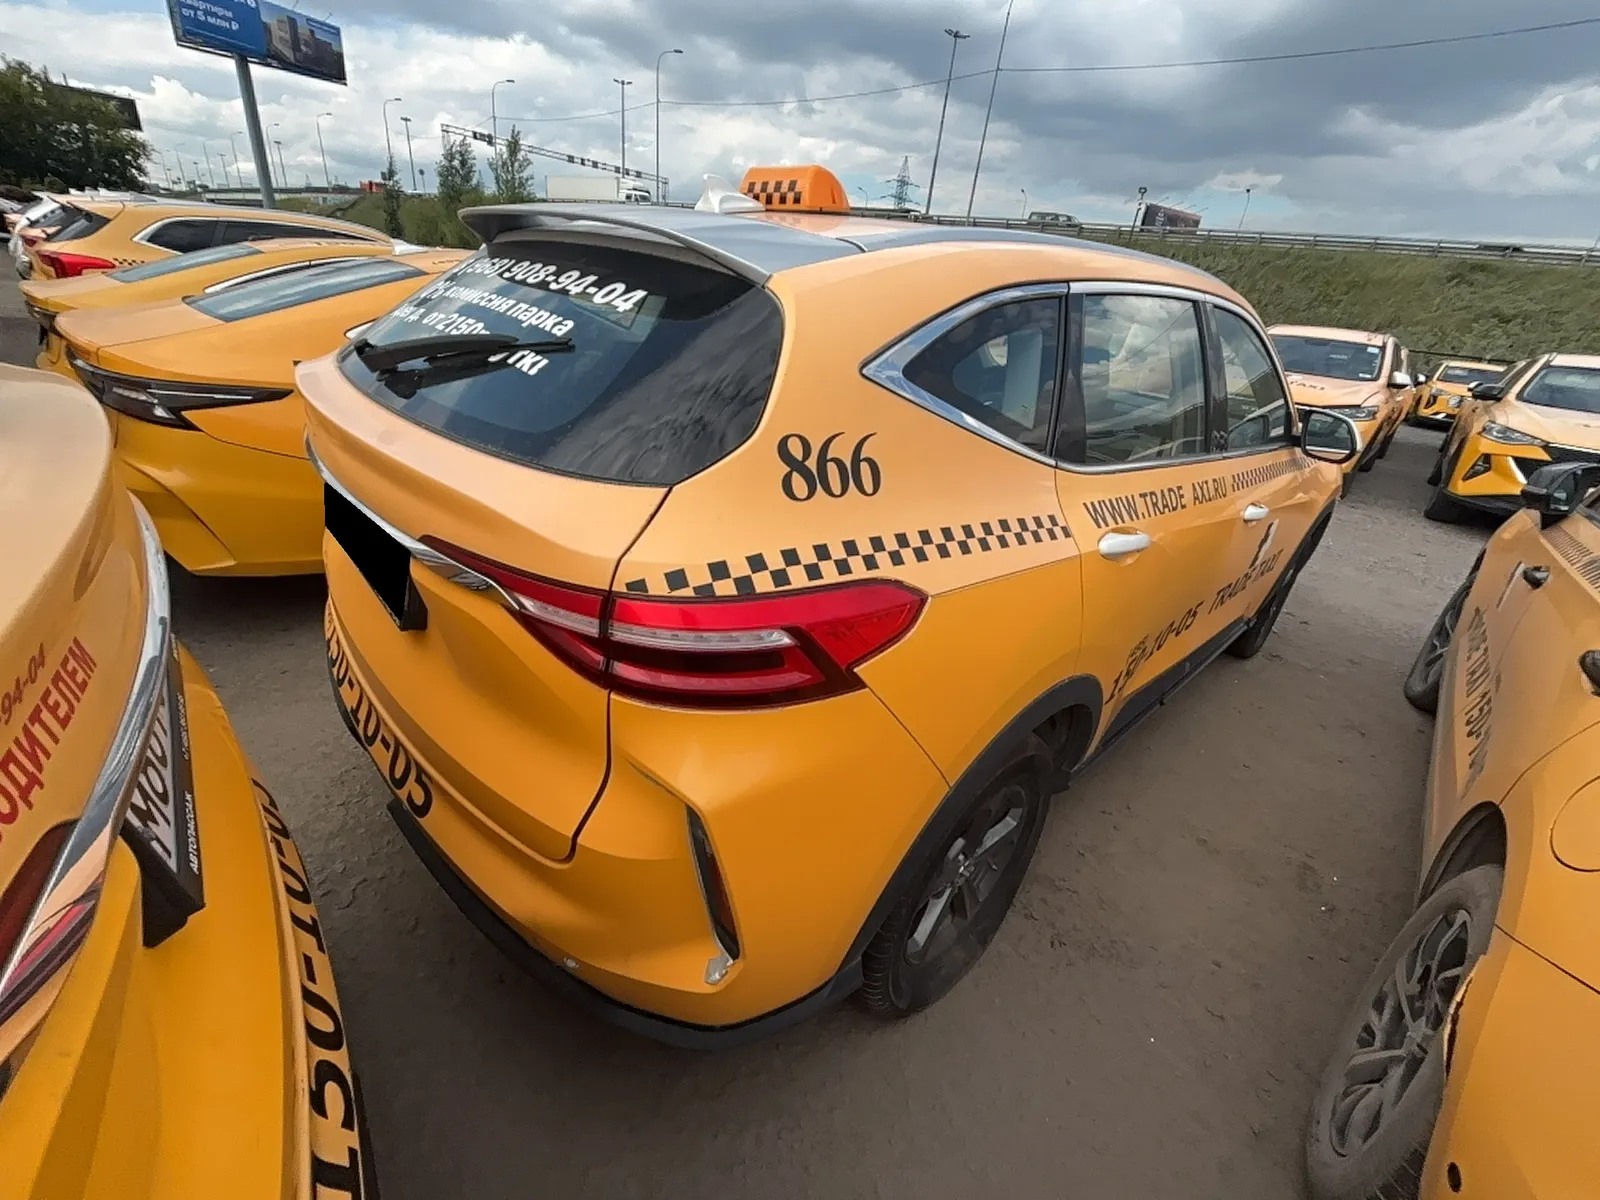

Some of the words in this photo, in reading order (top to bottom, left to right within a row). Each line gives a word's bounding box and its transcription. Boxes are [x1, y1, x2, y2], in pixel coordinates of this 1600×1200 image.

[179, 0, 233, 18] вартиры
[196, 10, 206, 21] 5
[207, 15, 229, 29] млн
[443, 284, 518, 319] комиссия
[507, 295, 575, 337] парка
[777, 432, 881, 502] 866
[0, 642, 46, 725] 94-04
[0, 636, 97, 843] ОДИТЕЛЕМ
